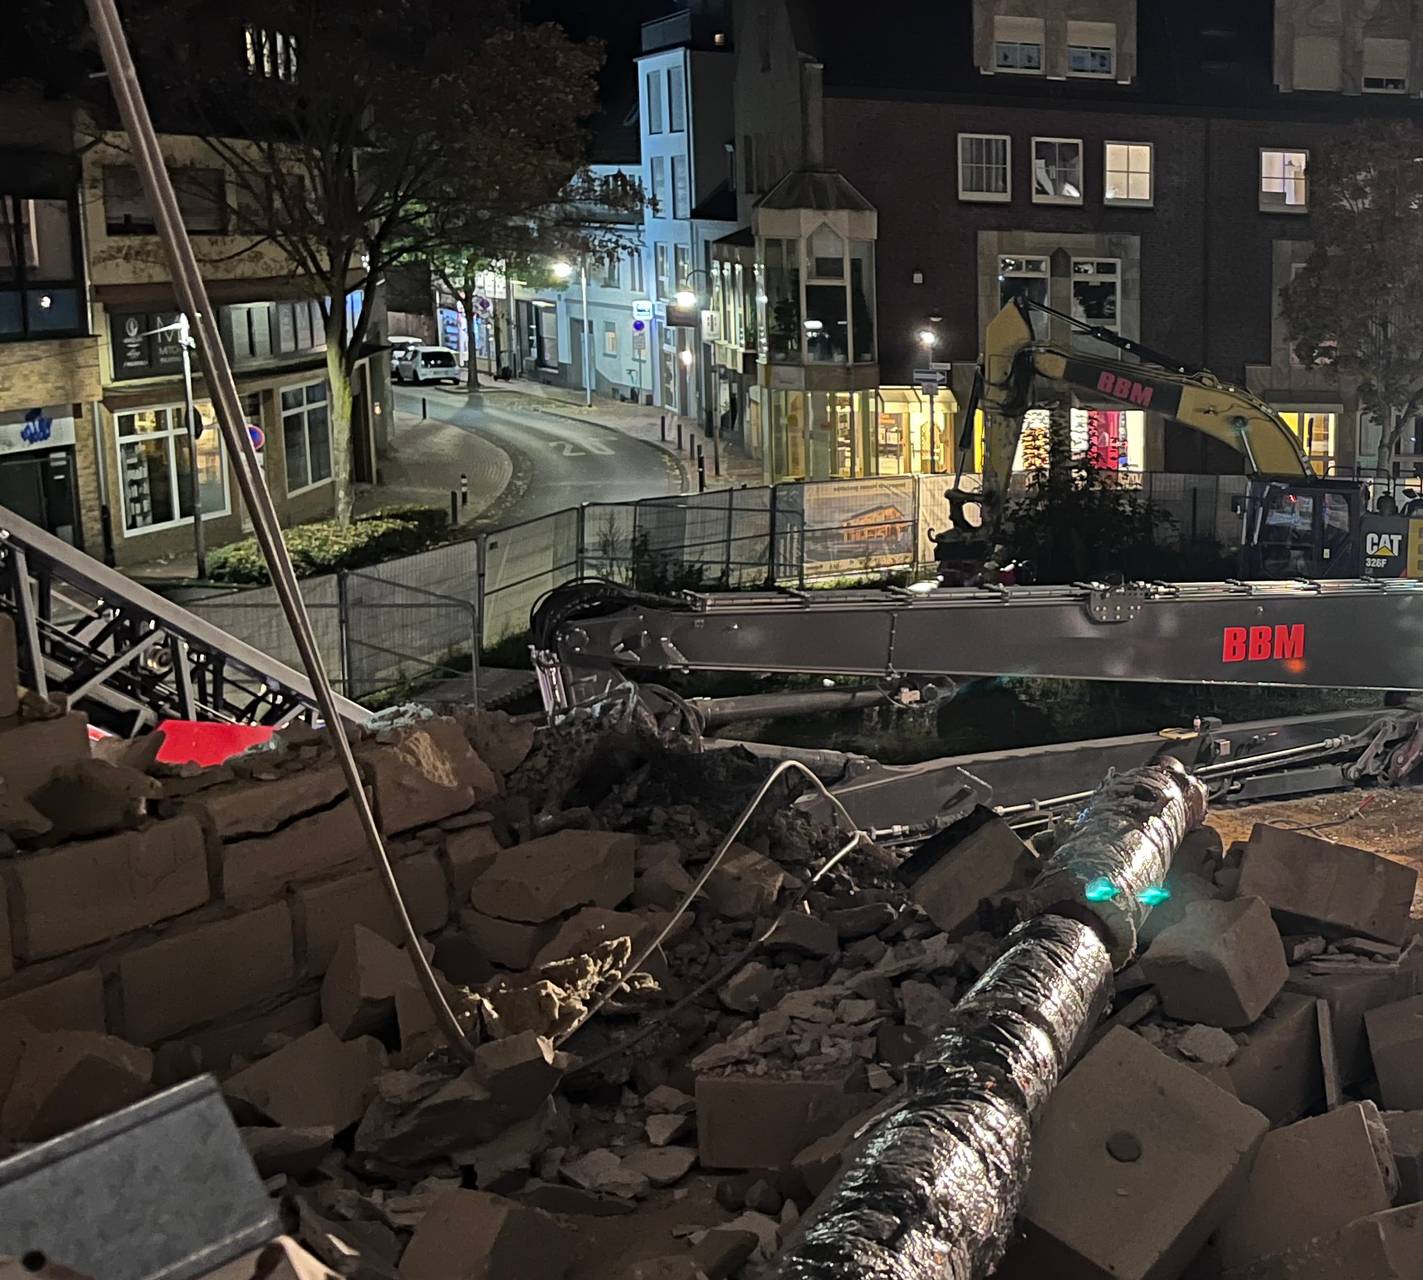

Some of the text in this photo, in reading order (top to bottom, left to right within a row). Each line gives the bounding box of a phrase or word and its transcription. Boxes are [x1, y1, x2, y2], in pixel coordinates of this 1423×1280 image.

[1097, 371, 1153, 407] BBM
[1366, 533, 1402, 556] CAT
[1365, 558, 1387, 568] 326F
[1222, 624, 1305, 662] BBM
